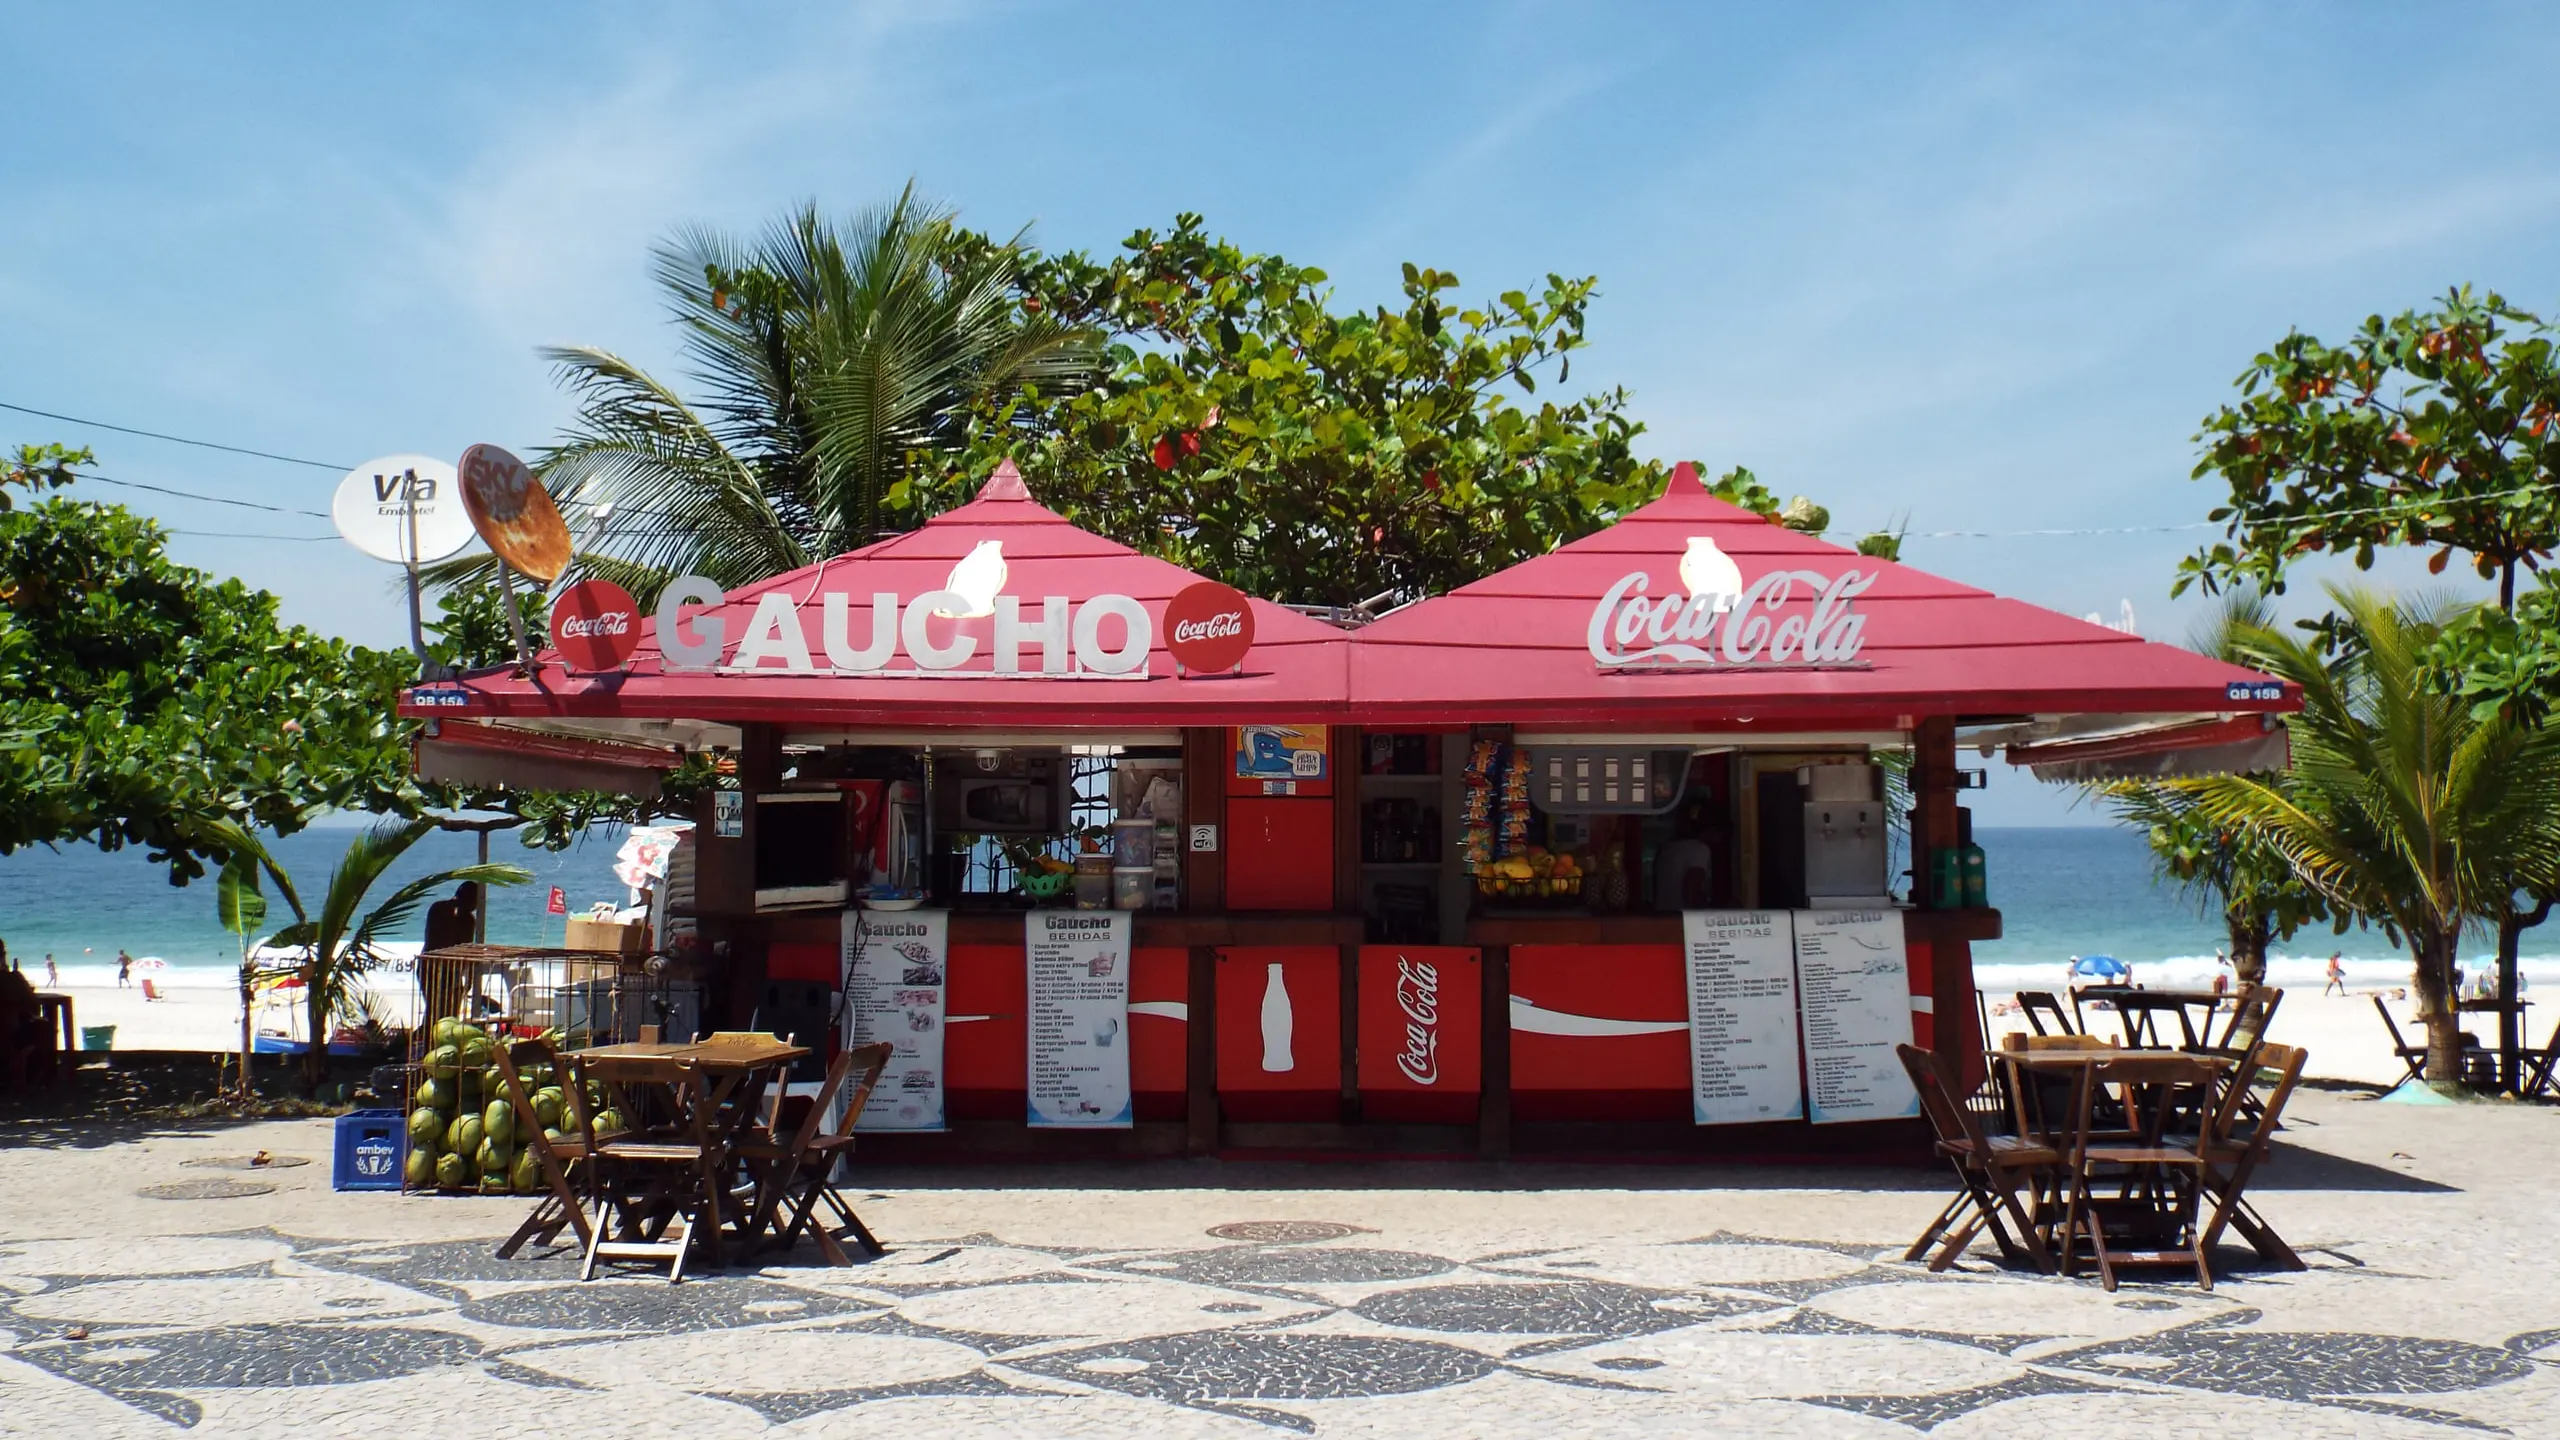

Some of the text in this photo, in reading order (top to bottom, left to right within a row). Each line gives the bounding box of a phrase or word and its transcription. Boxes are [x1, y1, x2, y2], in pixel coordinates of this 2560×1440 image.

[561, 611, 630, 639] Coca-Cola
[655, 575, 1152, 674] GAUCHO
[1587, 569, 1880, 664] Coca-Cola
[1174, 611, 1243, 643] Coca-Cola
[415, 696, 436, 706] QB
[2229, 688, 2281, 700] QB 15B
[1049, 932, 1111, 940] BEBIDAS
[356, 1144, 395, 1155] ambev
